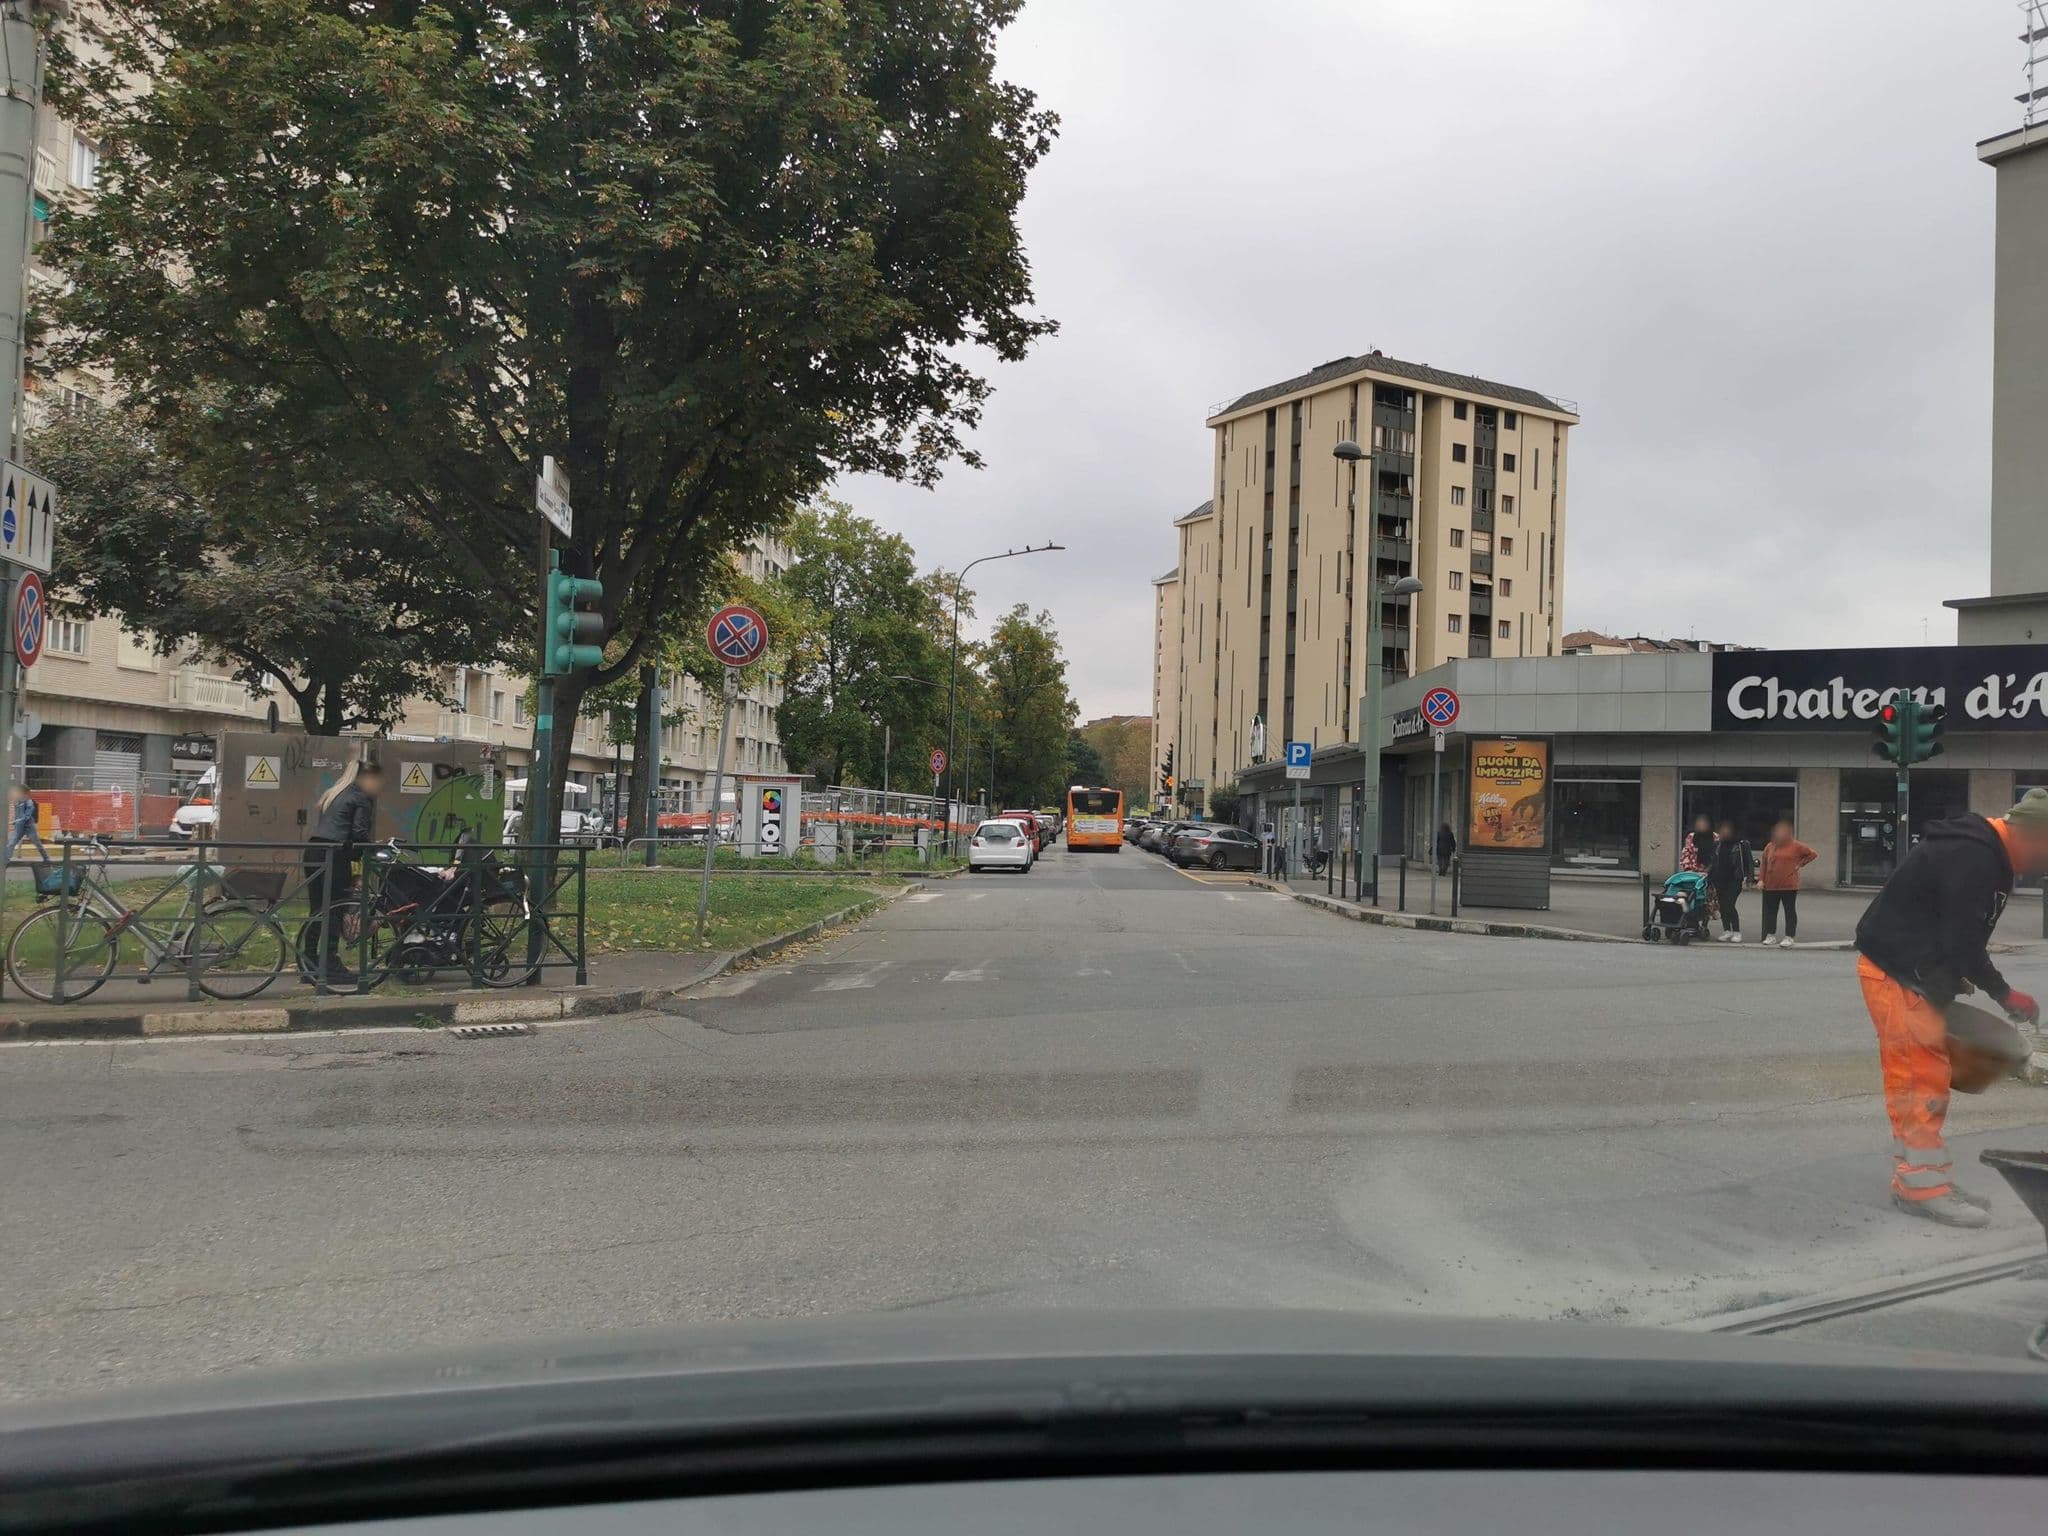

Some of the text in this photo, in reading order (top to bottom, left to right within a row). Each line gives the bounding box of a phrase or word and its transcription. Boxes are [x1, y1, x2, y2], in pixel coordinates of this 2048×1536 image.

[1291, 745, 1307, 764] P
[1477, 756, 1540, 768] BUONI DA
[1476, 767, 1542, 779] IMPAZZIRE
[761, 790, 782, 853] FOTO
